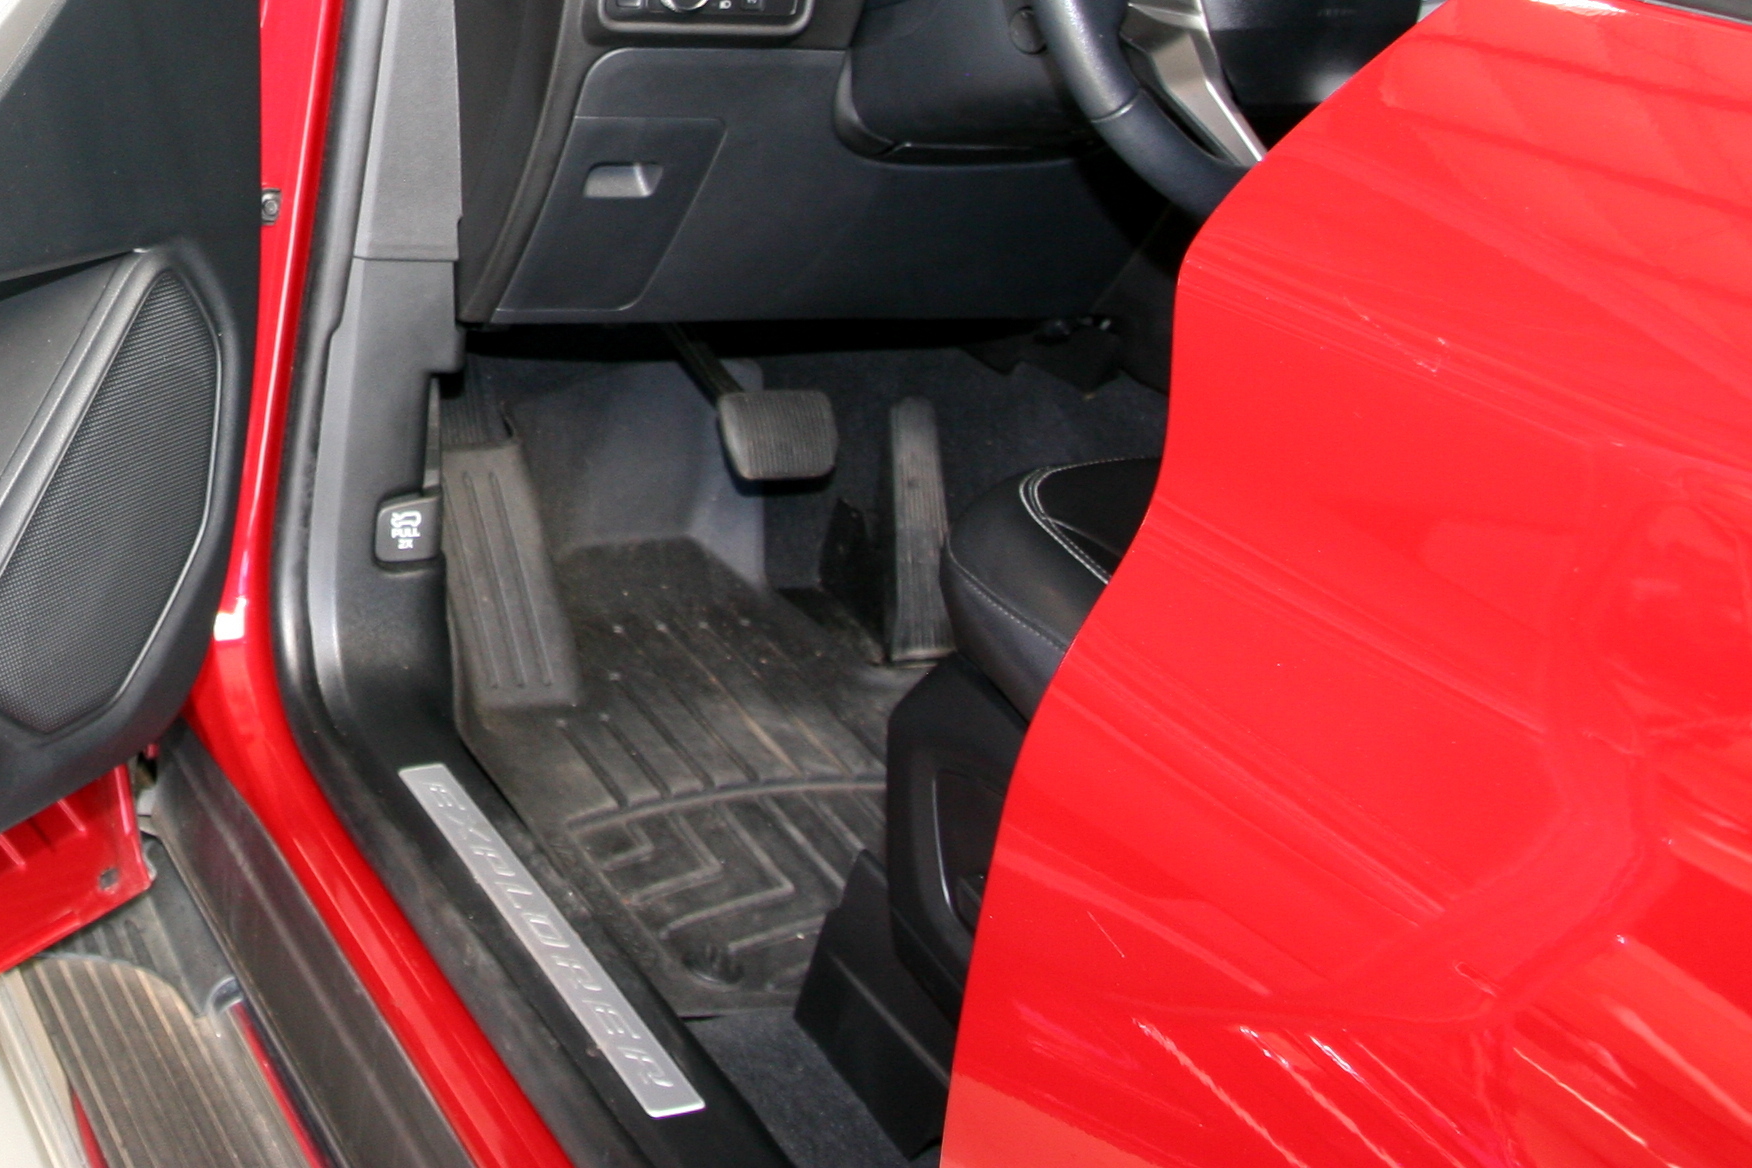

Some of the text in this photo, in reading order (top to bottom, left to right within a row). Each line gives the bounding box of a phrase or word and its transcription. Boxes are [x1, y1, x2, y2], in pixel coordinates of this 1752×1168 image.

[391, 527, 421, 539] PULL
[397, 538, 414, 550] 2X
[421, 780, 676, 1089] EXPLORER
